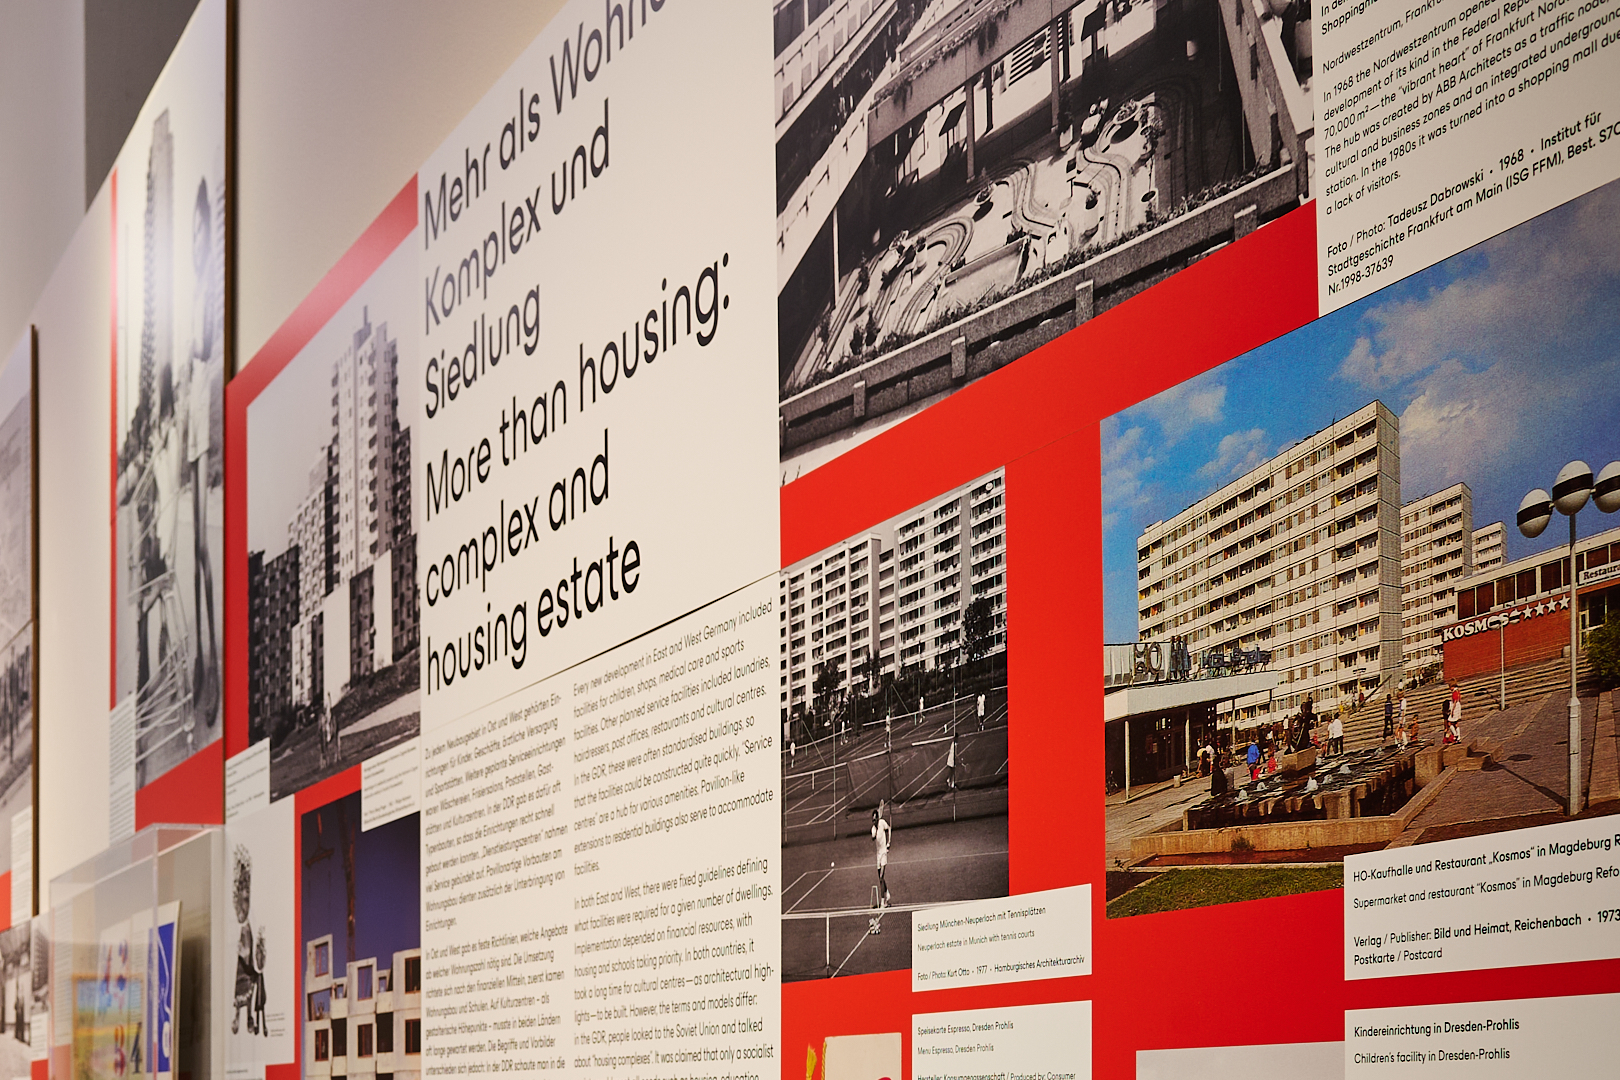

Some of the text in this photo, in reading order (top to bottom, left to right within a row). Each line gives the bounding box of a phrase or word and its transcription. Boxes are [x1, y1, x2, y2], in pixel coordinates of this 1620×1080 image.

[424, 0, 666, 250] Mehr als Wohn
[1325, 144, 1341, 158] The
[1344, 132, 1360, 148] hub
[1363, 122, 1380, 137] was
[1383, 96, 1419, 126] created
[1422, 91, 1434, 104] by
[1436, 76, 1456, 97] ABB
[1459, 48, 1512, 84] Architects
[1515, 39, 1527, 52] as
[1530, 33, 1537, 44] a
[1540, 12, 1574, 38] traffic
[1326, 150, 1359, 178] cultural
[1362, 139, 1379, 158] and
[1382, 119, 1421, 147] business
[1423, 102, 1451, 124] zones
[1453, 87, 1472, 107] and
[1476, 82, 1488, 95] an
[1491, 46, 1547, 86] integrated
[1326, 174, 1359, 197] station.
[1362, 167, 1369, 177] In
[1372, 158, 1387, 172] the
[1390, 141, 1416, 162] 1980s
[1419, 135, 1425, 146] it
[1428, 125, 1447, 141] was
[1450, 102, 1482, 130] turned
[1486, 94, 1506, 111] into
[1508, 88, 1515, 98] a
[1519, 59, 1569, 93] shopping
[1573, 40, 1598, 64] mall
[424, 98, 610, 335] Komplex und
[1327, 171, 1401, 215] a lack of visitors.
[1328, 112, 1601, 258] Foto Photo: Tadeusz Dabrowski 1968 Institut für
[1328, 137, 1596, 277] Stadtgeschichte Frankfurt am Main (ISG FFM), Best.
[426, 284, 540, 418] Siedlung
[426, 252, 730, 521] More than housing:
[426, 429, 610, 607] complex and
[428, 536, 642, 695] housing estate
[1354, 865, 1413, 882] HO-Kaufhalle
[1416, 861, 1432, 874] und
[1435, 854, 1486, 871] Restaurant
[1538, 846, 1546, 857] in
[1550, 839, 1611, 856] Magdeburg
[1354, 893, 1407, 910] Supermarket
[1409, 890, 1426, 902] and
[1428, 885, 1475, 899] restaurant
[1523, 877, 1531, 888] in
[1534, 871, 1593, 888] Magdeburg
[1354, 936, 1382, 948] Verlag
[1391, 931, 1432, 944] Publisher:
[1434, 927, 1451, 940] Bild
[1454, 925, 1471, 938] und
[1475, 922, 1512, 935] Heimat,
[1515, 914, 1582, 931] Reichenbach
[1355, 948, 1442, 965] Postkarte Postcard
[1355, 1019, 1520, 1037] Kindereinrichtung in Dresden-Prohlis
[1397, 1052, 1426, 1064] facility
[1429, 1051, 1436, 1061] in
[1439, 1048, 1510, 1061] Dresden-Prohlis
